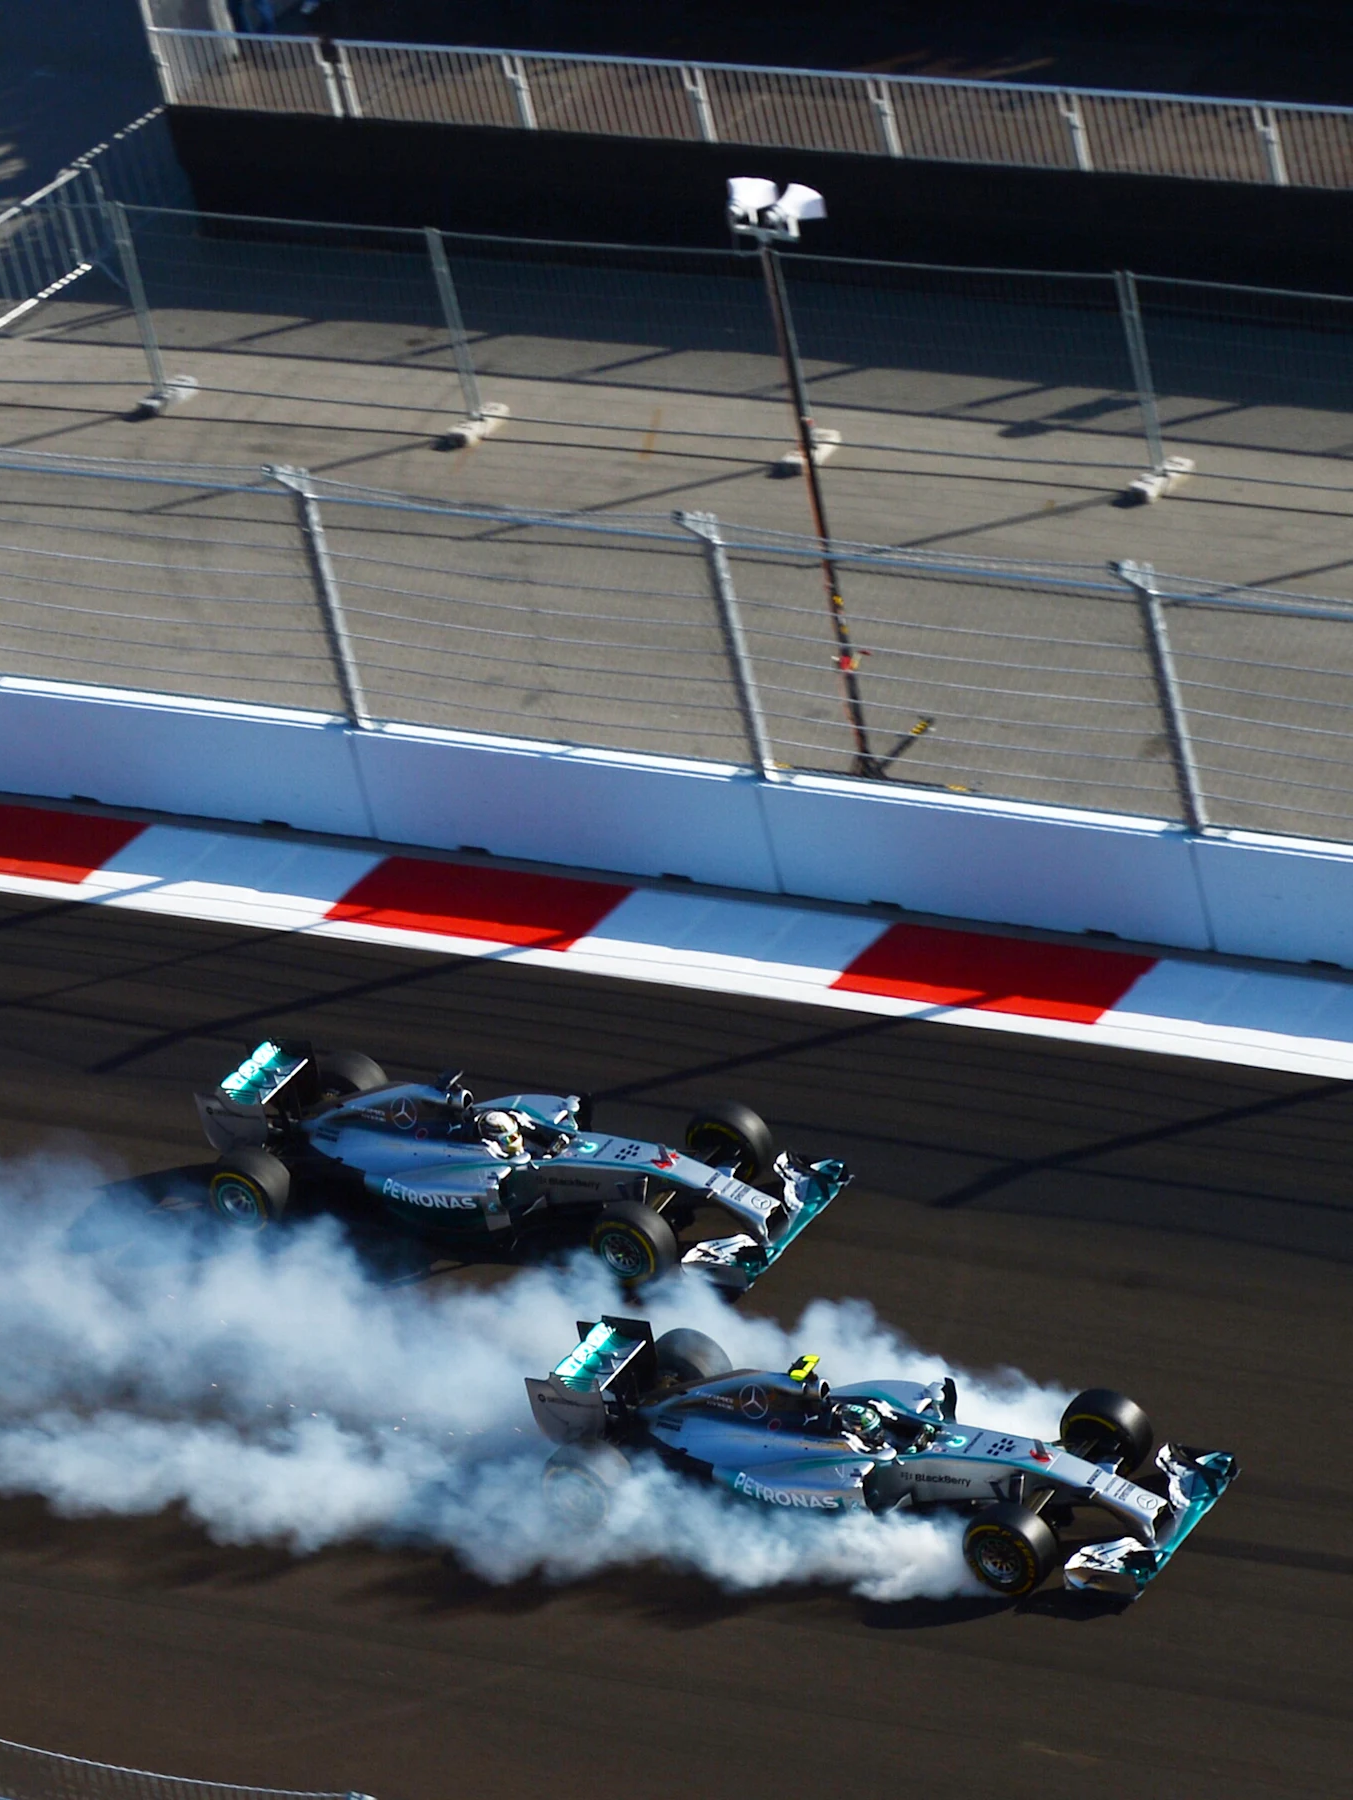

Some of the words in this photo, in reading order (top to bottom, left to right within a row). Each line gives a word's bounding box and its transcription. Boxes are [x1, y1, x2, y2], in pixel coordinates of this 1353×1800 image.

[383, 1178, 477, 1209] PETRONAS
[733, 1471, 839, 1509] PETRONAS
[915, 1473, 971, 1487] BlackBerry
